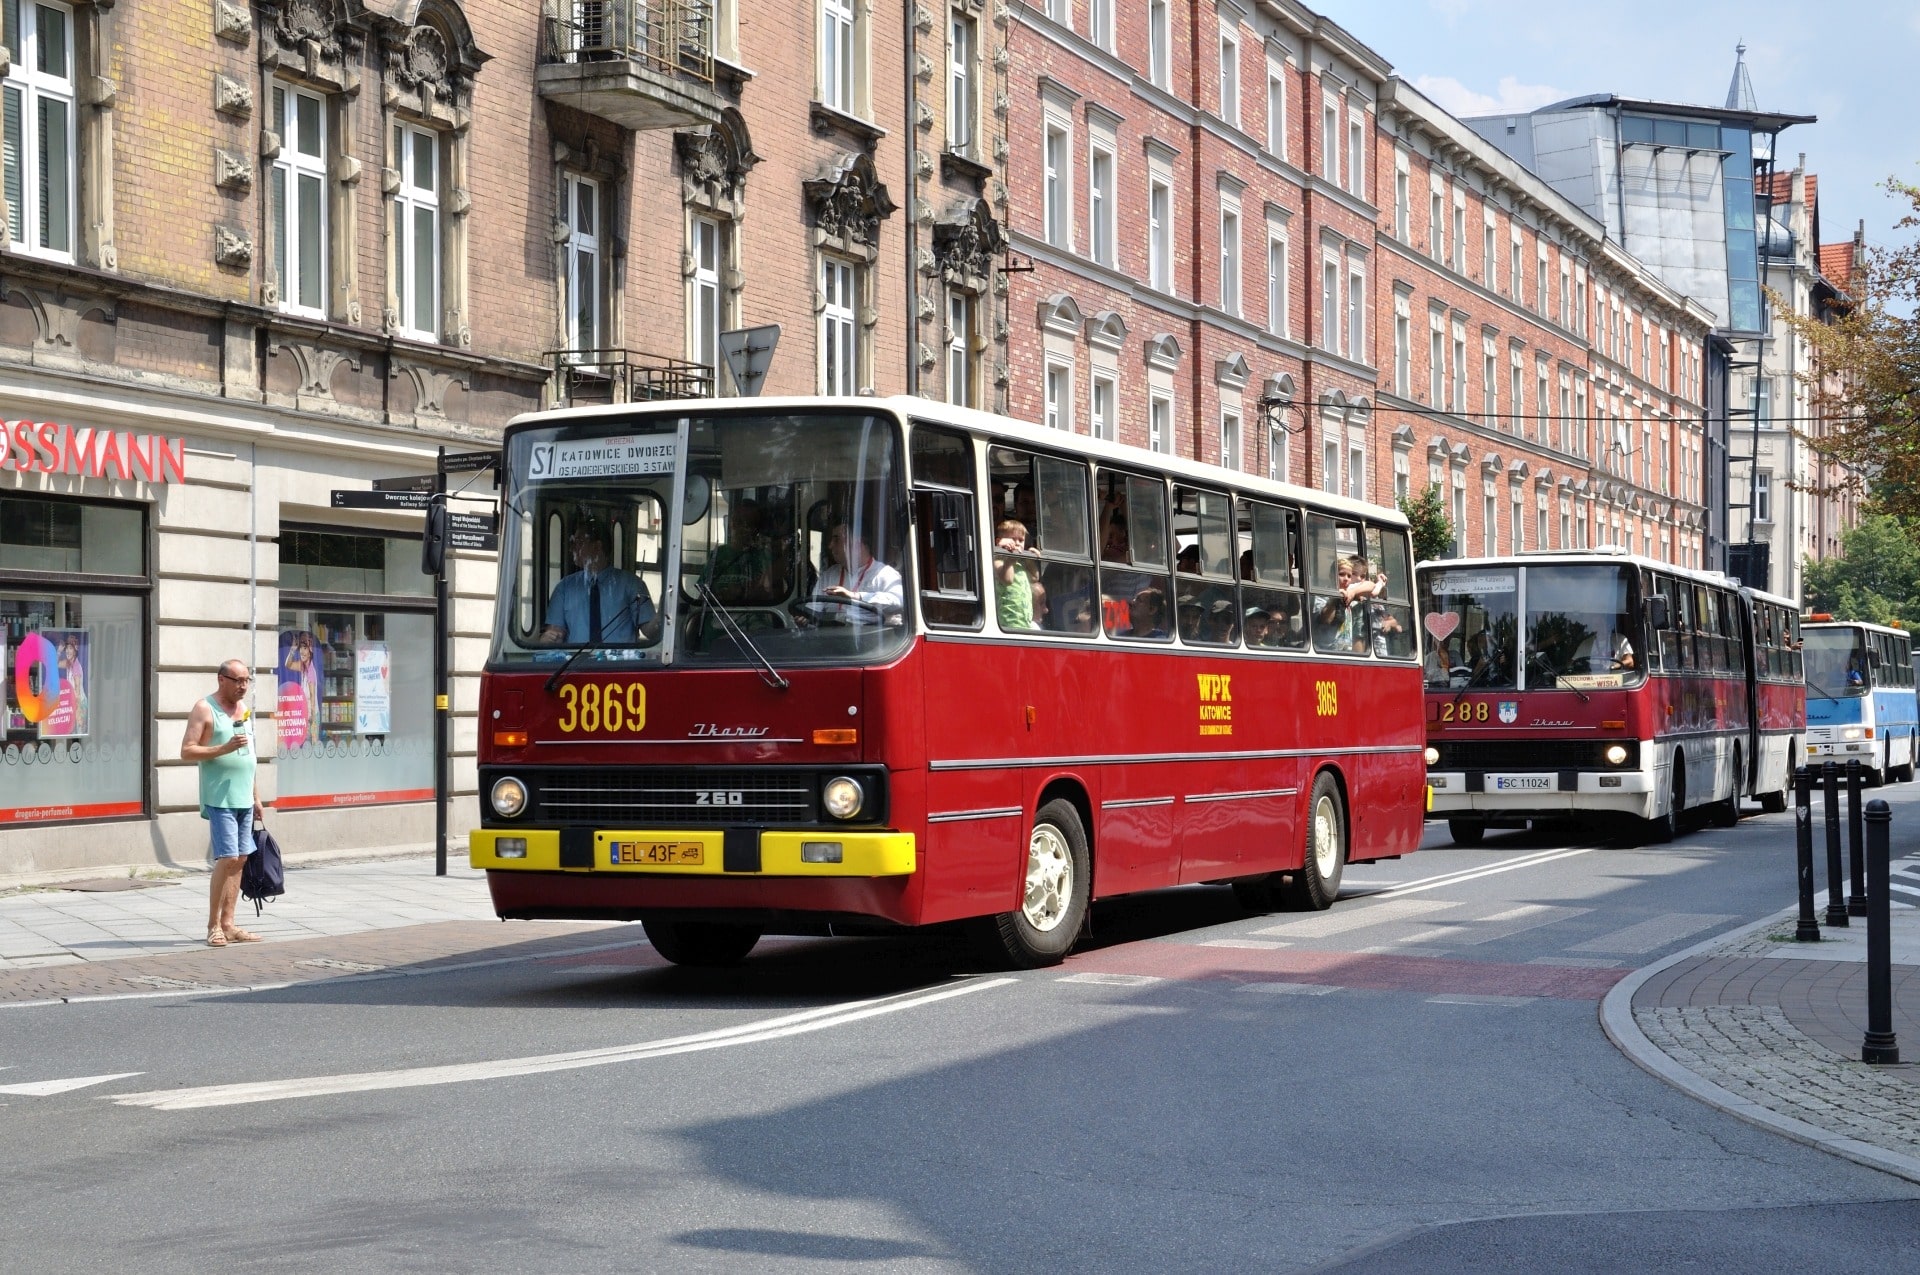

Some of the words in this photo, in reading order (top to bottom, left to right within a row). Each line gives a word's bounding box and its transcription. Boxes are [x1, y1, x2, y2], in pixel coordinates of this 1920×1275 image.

[532, 446, 554, 474] S1
[561, 448, 621, 461] KATOWICE
[643, 462, 649, 472] 3
[385, 493, 408, 501] Dworzec
[1197, 673, 1232, 701] WPK
[1316, 680, 1338, 716] 3869
[558, 682, 647, 732] 3869
[1199, 705, 1232, 720] KATOWICE
[1442, 701, 1489, 722] 288
[1530, 718, 1575, 726] Ikarus
[688, 724, 770, 737] Ikarus
[1503, 778, 1518, 788] SC
[1521, 778, 1549, 788] 11024
[15, 806, 73, 819] drogeria-perfumeria
[621, 844, 642, 862] EL
[648, 844, 678, 862] 43F
